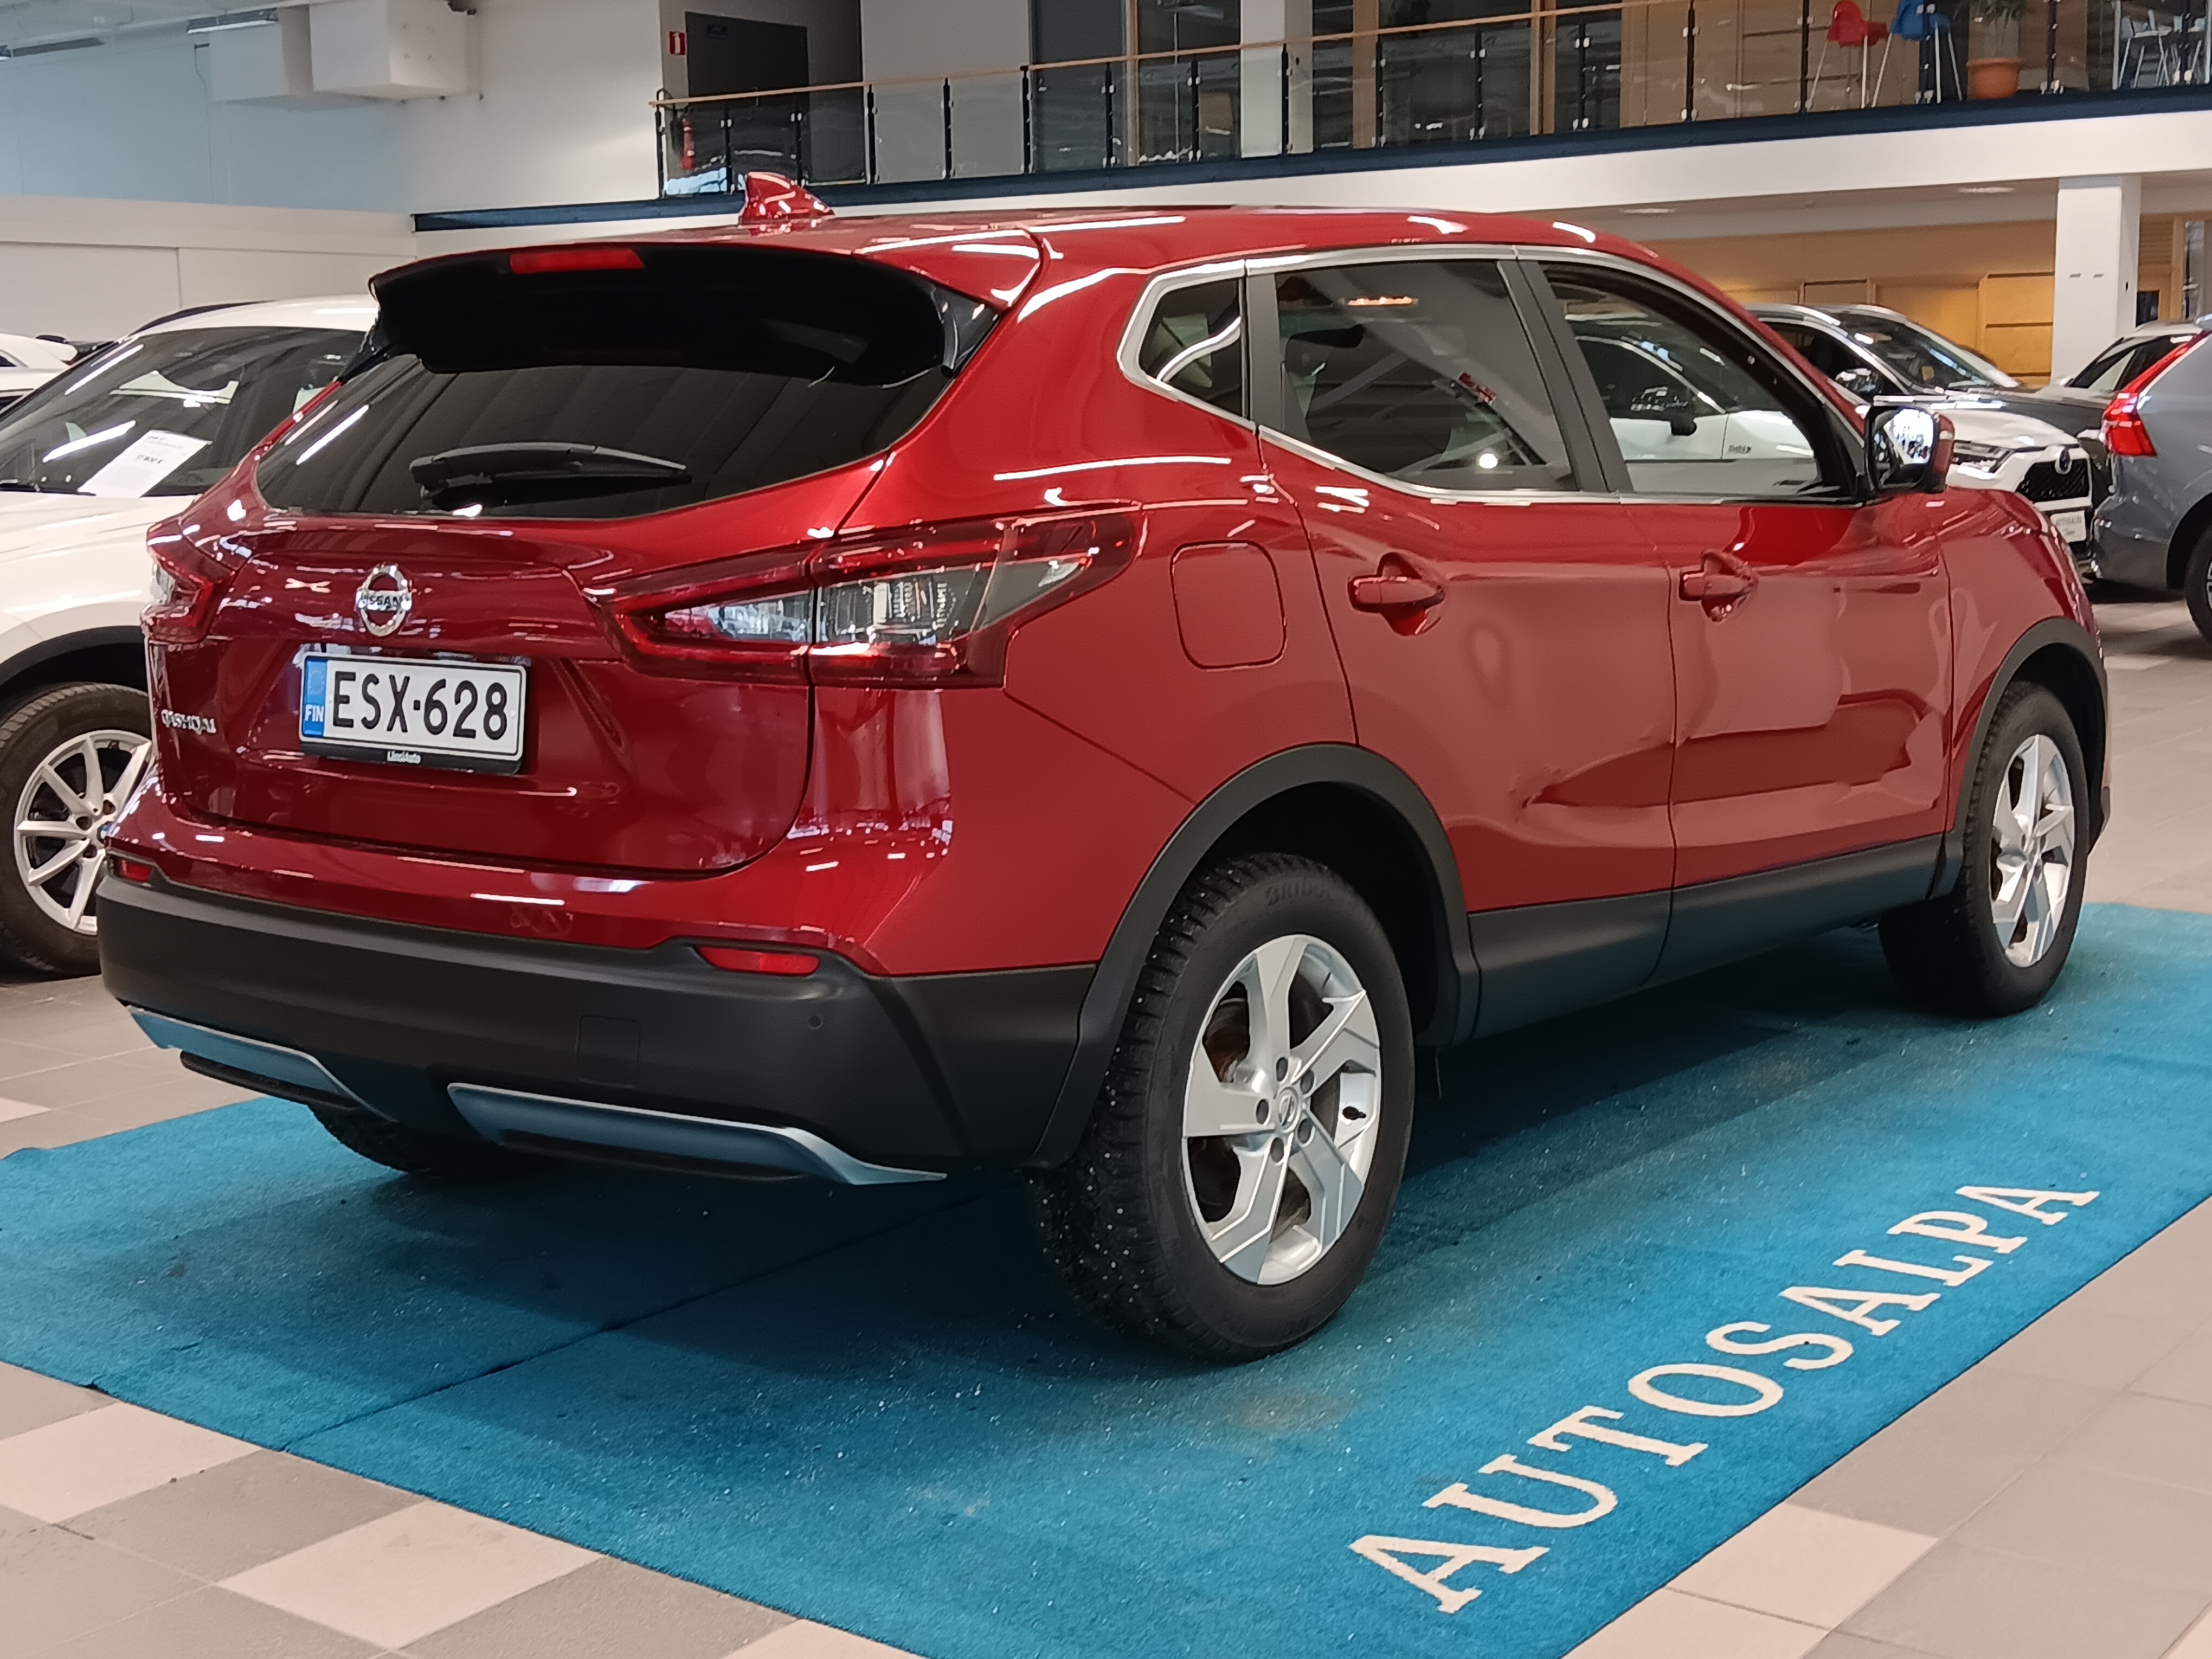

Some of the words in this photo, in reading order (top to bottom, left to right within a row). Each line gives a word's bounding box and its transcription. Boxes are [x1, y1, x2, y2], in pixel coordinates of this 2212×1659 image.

[304, 704, 324, 723] FIN
[332, 670, 508, 741] ESX-628
[1349, 1185, 2100, 1614] AUTOSALPA
